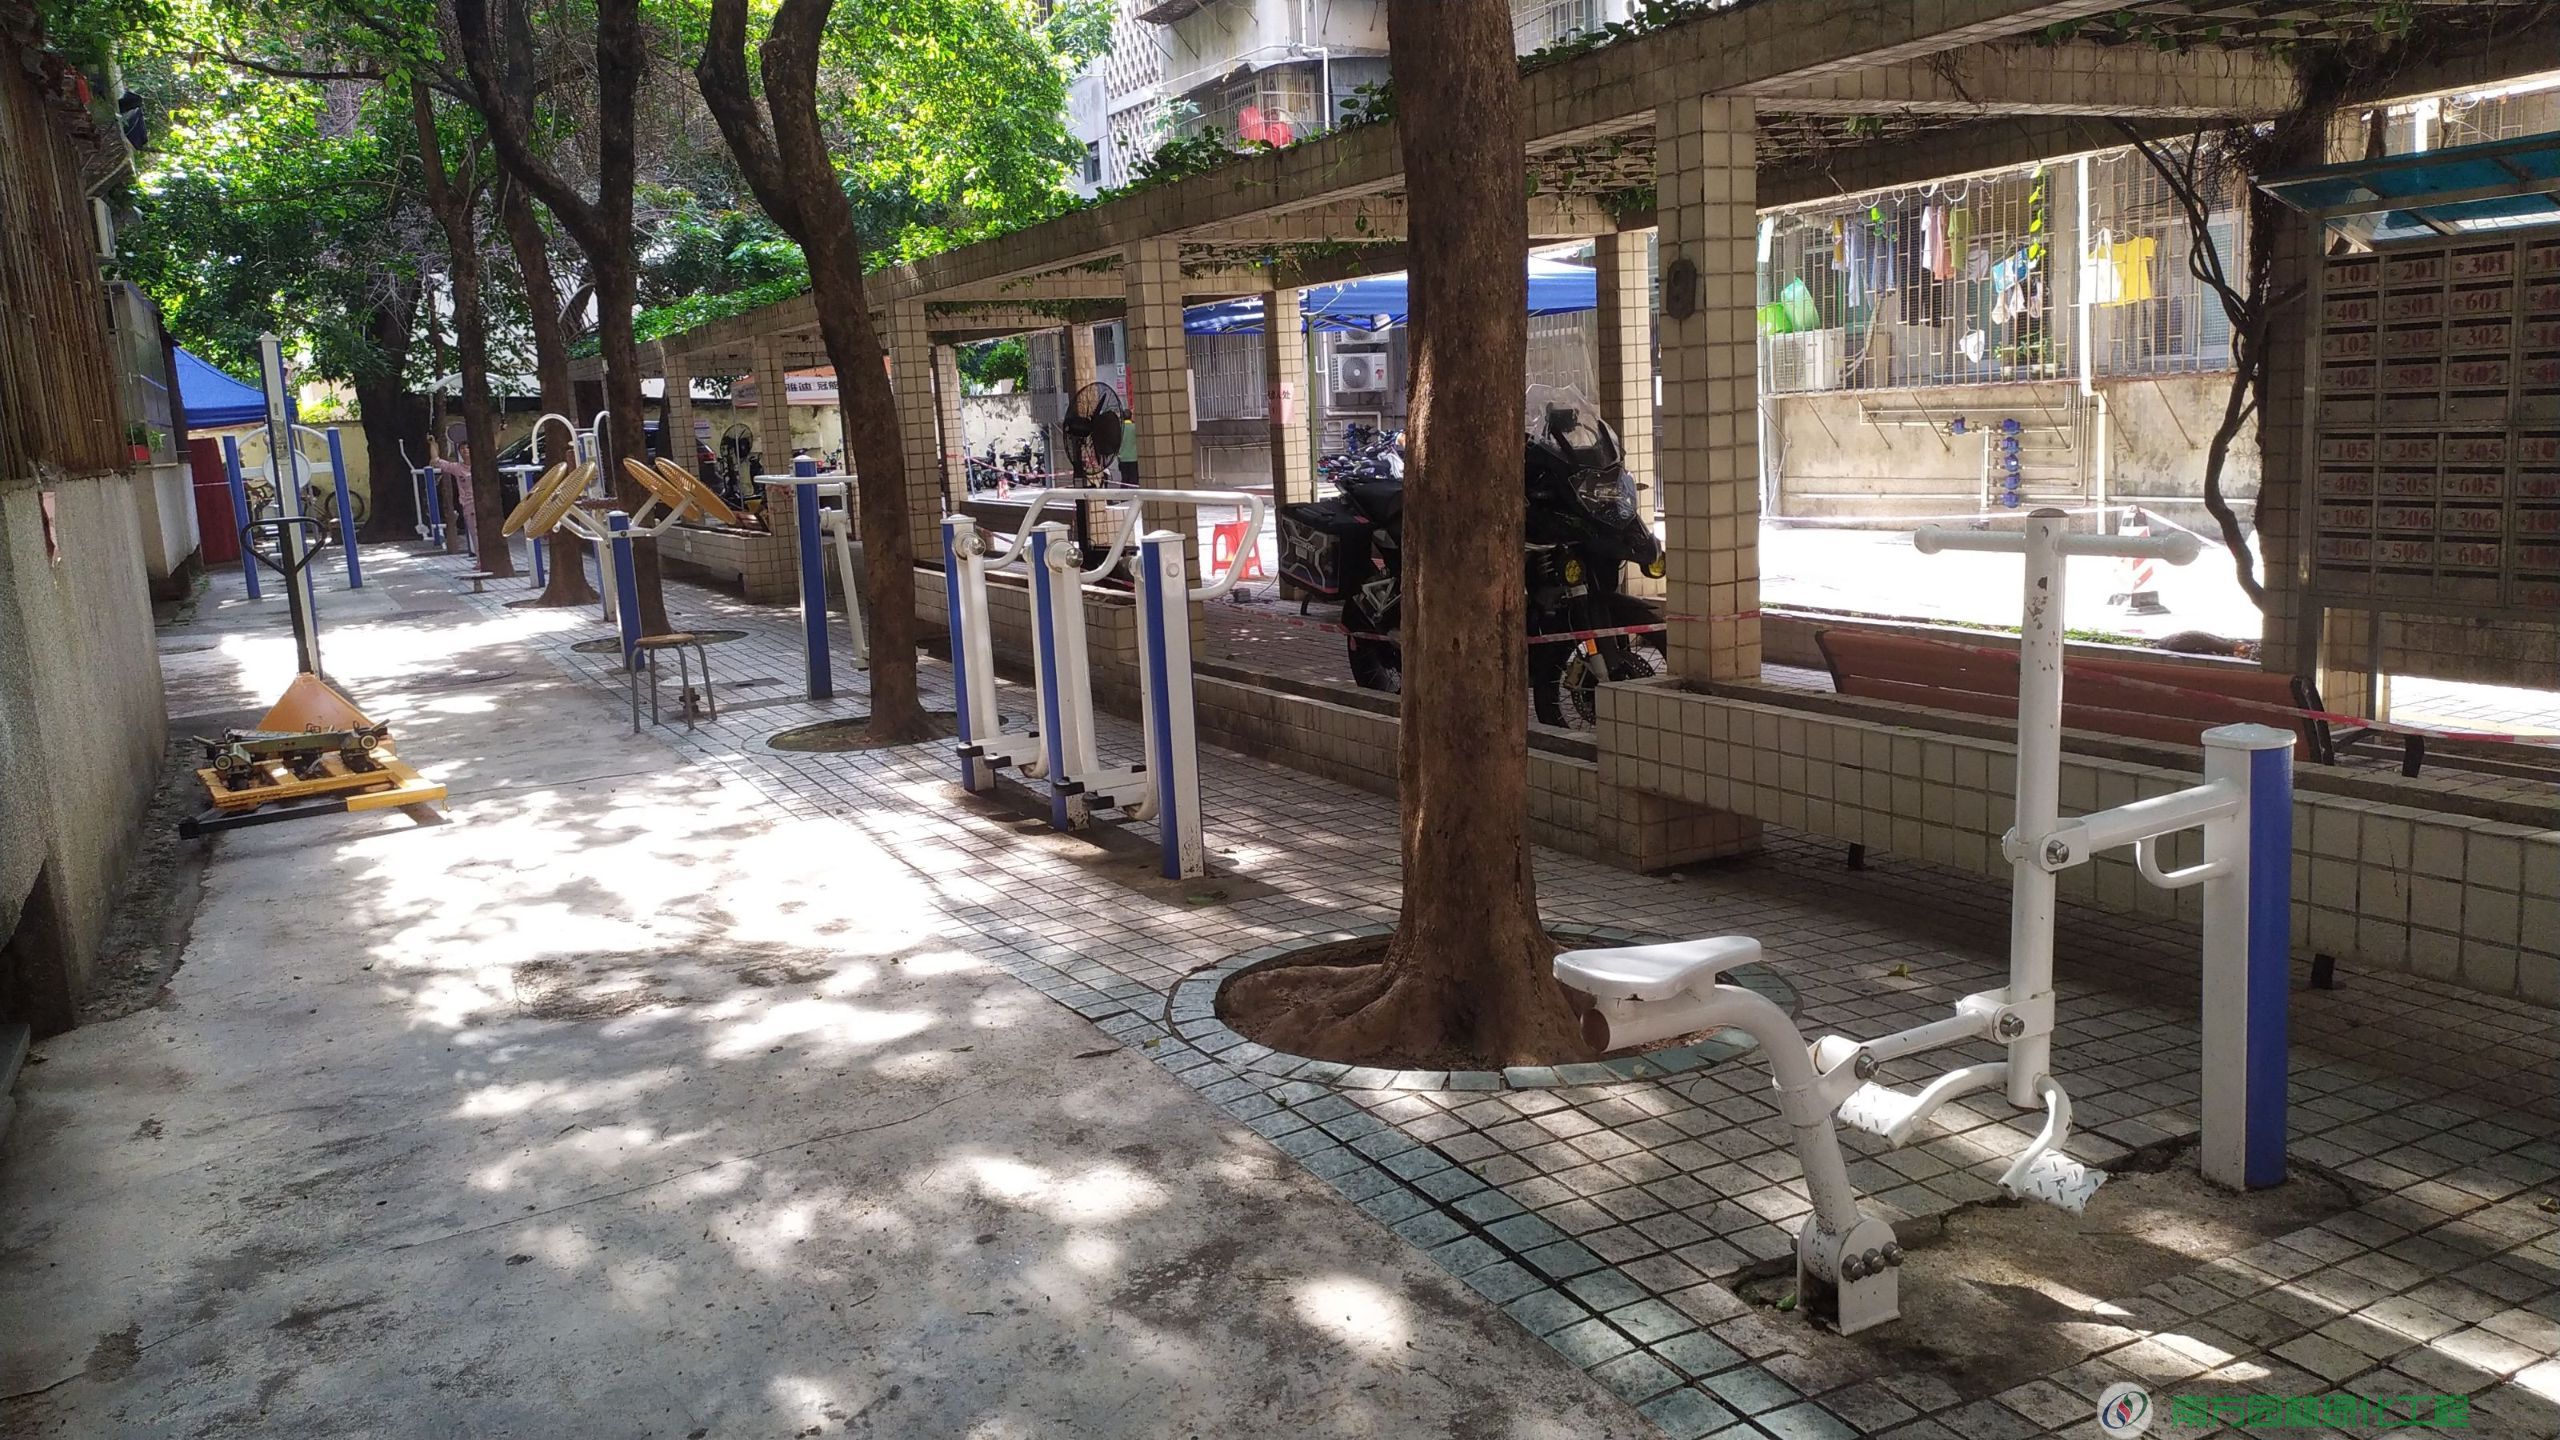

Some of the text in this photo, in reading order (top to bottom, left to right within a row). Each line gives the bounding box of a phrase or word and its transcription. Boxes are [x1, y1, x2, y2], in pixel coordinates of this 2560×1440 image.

[2403, 260, 2436, 280] 201
[2469, 254, 2505, 274] 301
[2339, 265, 2371, 283] 101
[2337, 302, 2369, 320] 401
[2400, 297, 2434, 315] 501
[2465, 293, 2504, 311] 601
[2338, 335, 2370, 353] 102
[2401, 330, 2435, 348] 202
[2466, 327, 2503, 346] 302
[2336, 368, 2369, 386] 402
[2399, 366, 2433, 385] 502
[2463, 364, 2502, 384] 602
[2337, 442, 2369, 460] 105
[2398, 442, 2432, 459] 205
[2463, 442, 2502, 460] 305
[2335, 475, 2369, 492] 405
[2395, 477, 2430, 494] 505
[2458, 476, 2497, 494] 605
[2335, 509, 2366, 526] 106
[2397, 509, 2432, 527] 206
[2457, 511, 2496, 530] 306
[2392, 544, 2428, 561] 506
